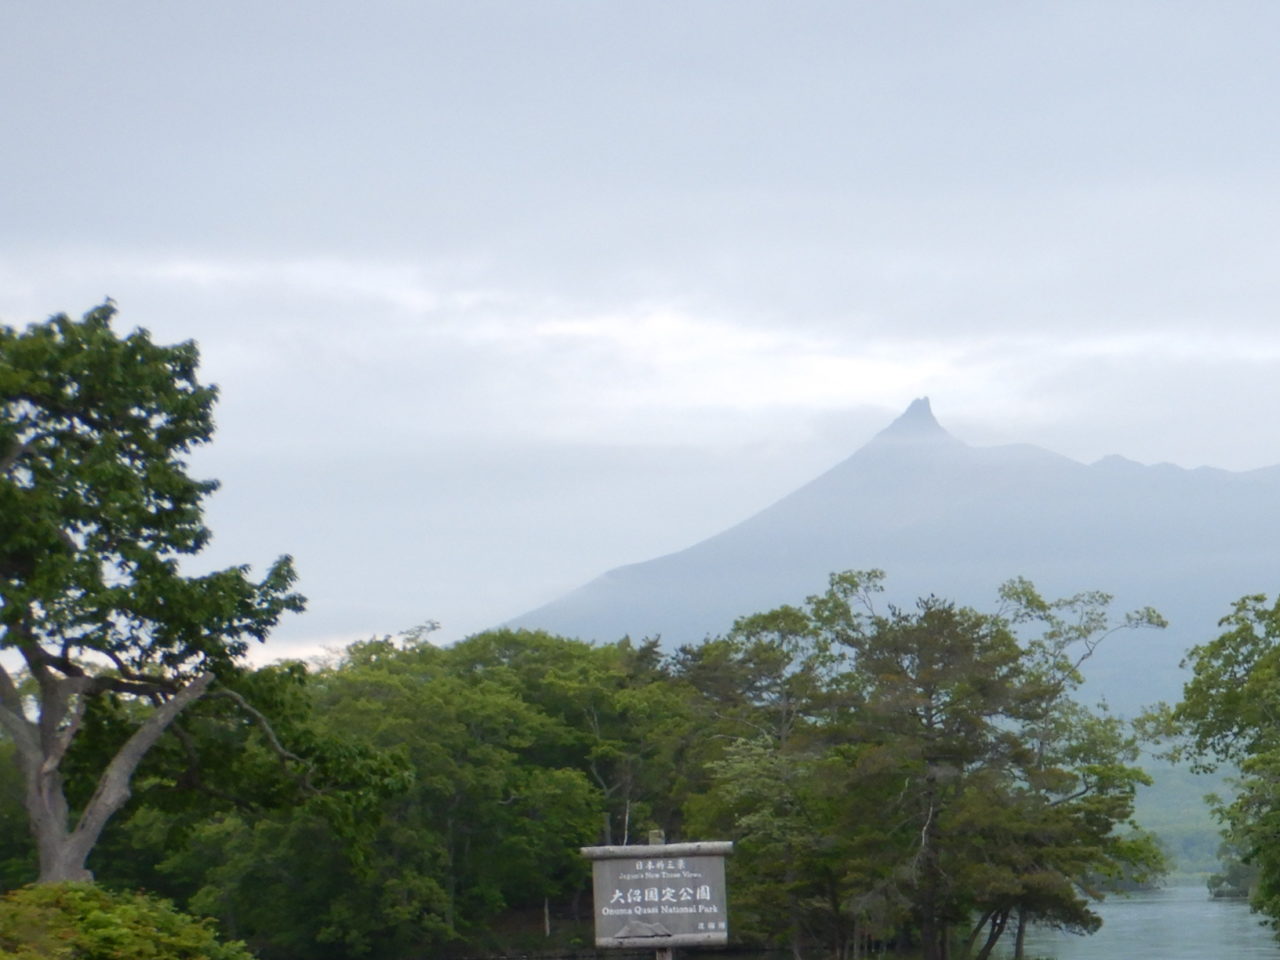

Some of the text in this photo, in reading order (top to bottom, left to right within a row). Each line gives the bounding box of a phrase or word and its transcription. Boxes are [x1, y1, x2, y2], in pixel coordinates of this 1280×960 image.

[602, 904, 718, 916] Onuma Quasi National Park
